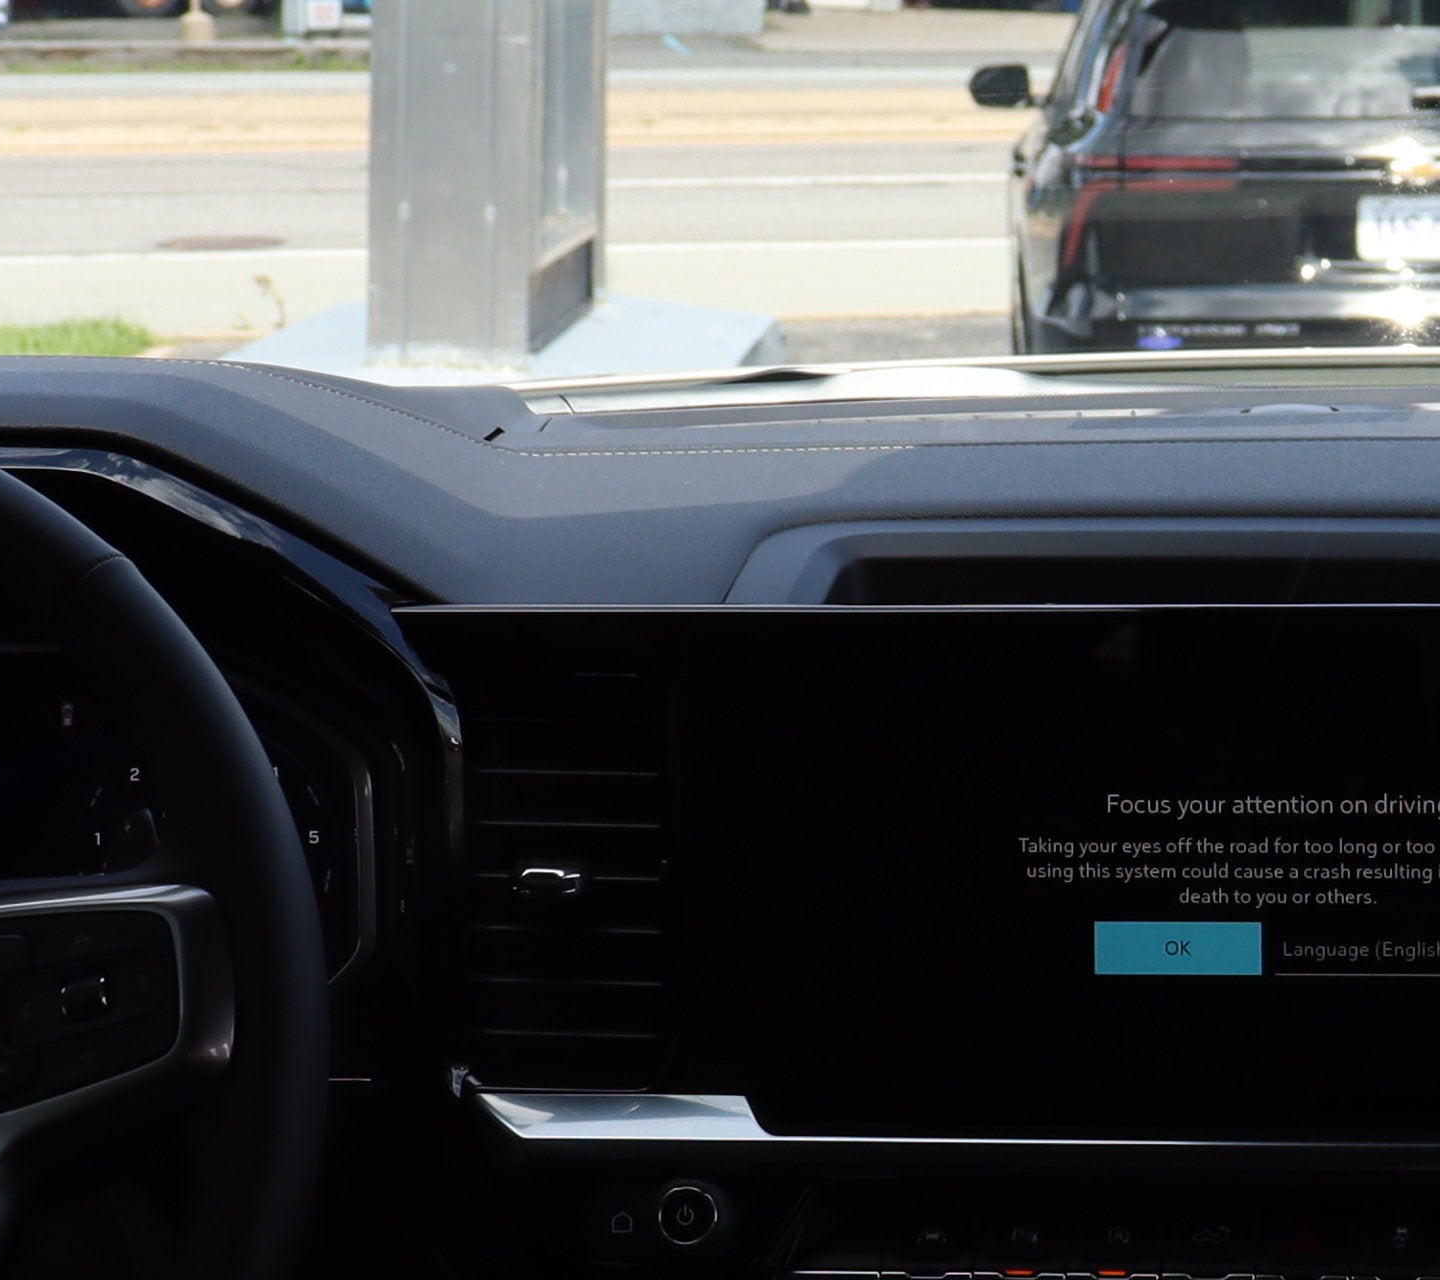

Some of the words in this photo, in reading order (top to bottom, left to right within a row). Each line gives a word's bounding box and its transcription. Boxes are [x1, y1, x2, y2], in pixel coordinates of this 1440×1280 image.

[130, 768, 139, 781] 2
[1107, 793, 1171, 814] Focus
[1176, 799, 1226, 820] your
[1232, 794, 1333, 814] attention
[1339, 799, 1367, 814] on
[309, 831, 319, 843] 5
[1021, 836, 1074, 858] Taking
[1078, 842, 1117, 858] your
[1122, 841, 1161, 858] eyes
[1166, 836, 1193, 853] off
[1196, 836, 1224, 853] the
[1230, 836, 1268, 853] road
[1273, 836, 1299, 854] for
[1303, 839, 1333, 854] too
[1338, 837, 1377, 859] long
[1382, 842, 1401, 854] or
[1405, 840, 1435, 854] too
[1026, 862, 1073, 883] using
[1078, 861, 1110, 878] this
[1115, 864, 1176, 883] system
[1181, 862, 1228, 878] could
[1233, 867, 1284, 879] cause
[1288, 867, 1298, 879] a
[1303, 862, 1350, 879] crash
[1356, 862, 1432, 884] resulting
[1178, 887, 1229, 904] death
[1232, 890, 1251, 904] to
[1255, 892, 1287, 909] you
[1291, 892, 1311, 904] or
[1315, 888, 1377, 904] others.
[1165, 941, 1191, 955] OK
[1283, 941, 1369, 962] Language
